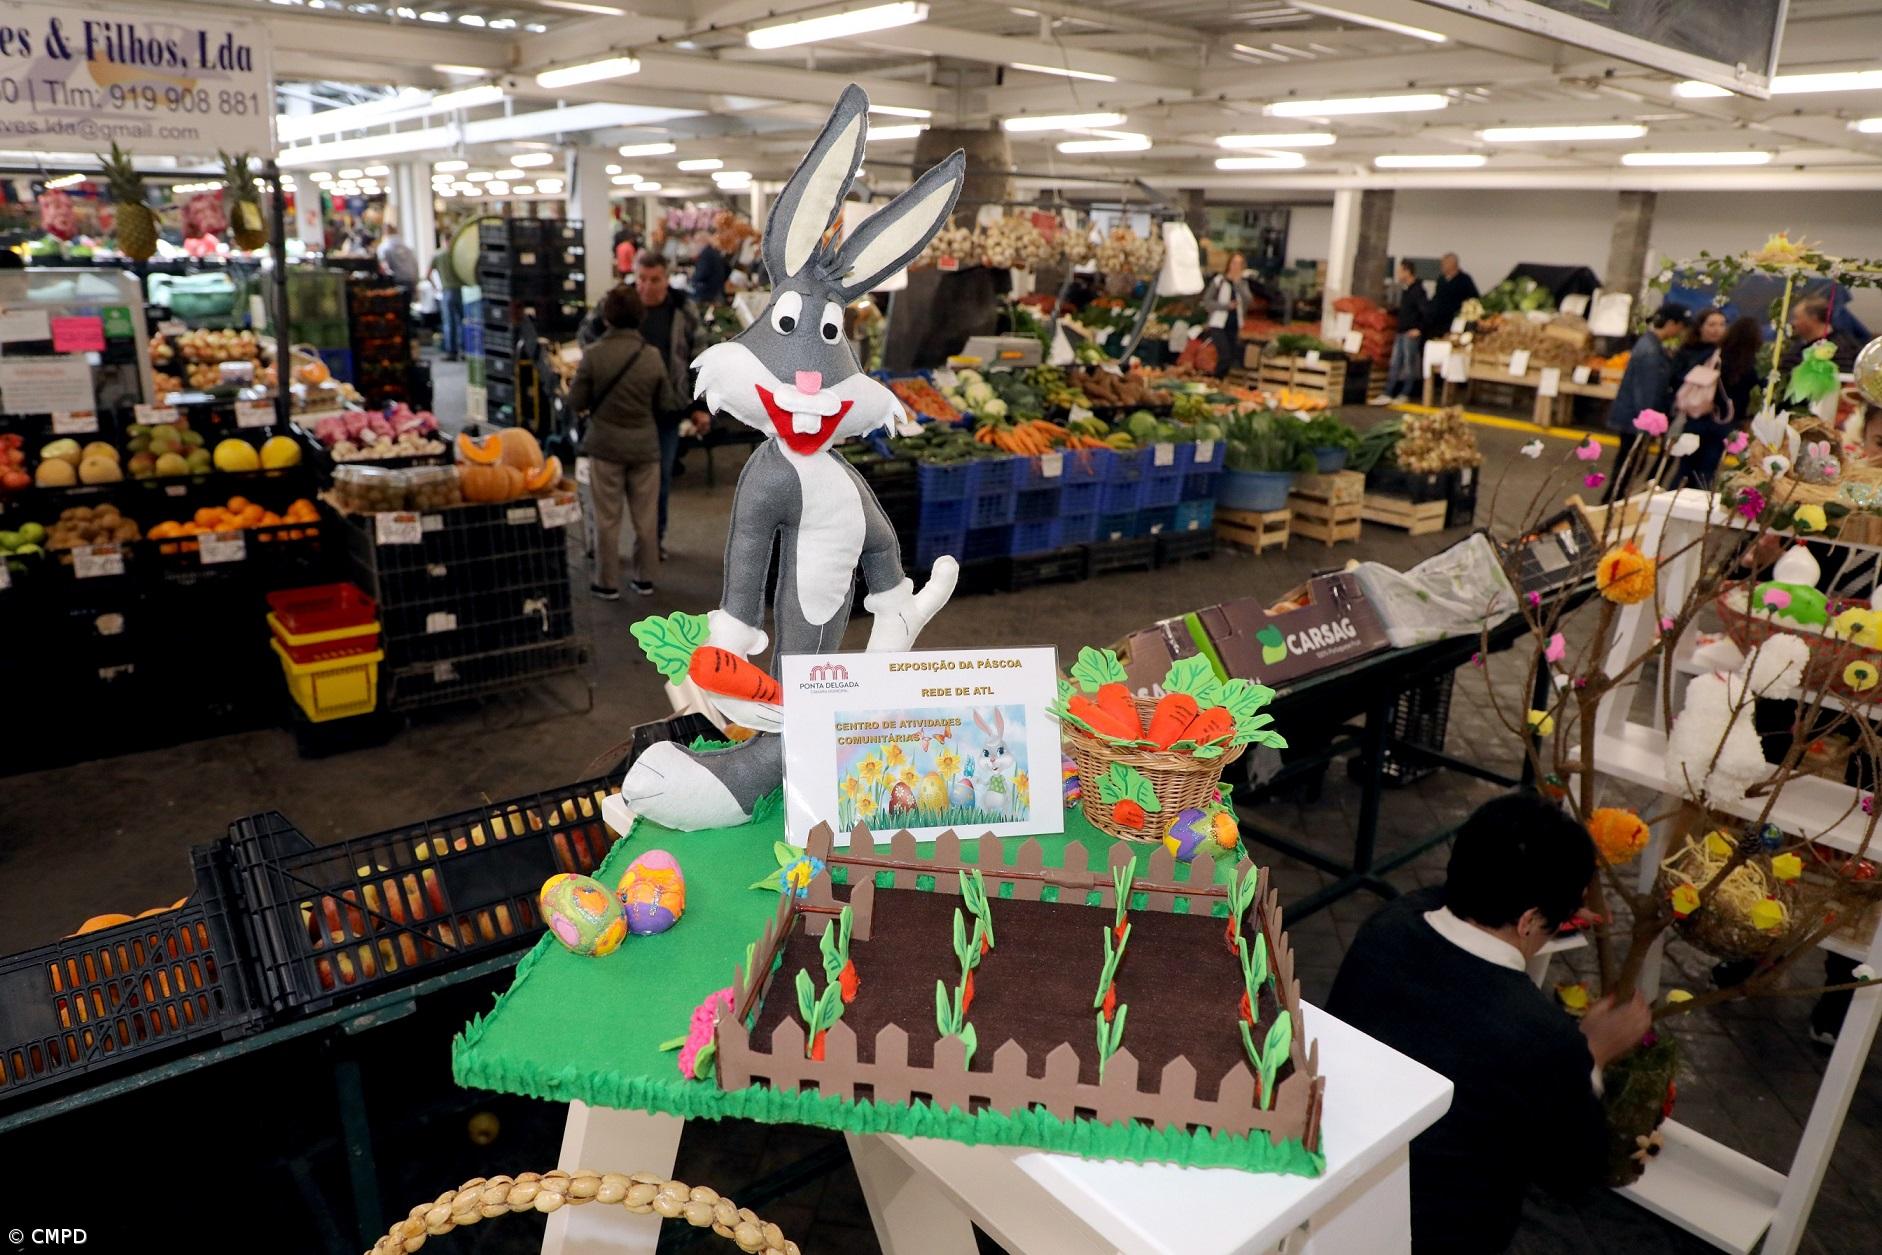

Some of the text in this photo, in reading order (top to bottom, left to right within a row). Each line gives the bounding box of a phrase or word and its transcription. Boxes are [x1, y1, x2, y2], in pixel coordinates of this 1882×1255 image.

[45, 17, 72, 60] &
[198, 30, 252, 71] Lda
[0, 77, 19, 104] 0
[42, 79, 103, 108] Tlm:
[110, 84, 157, 110] 919
[165, 87, 210, 114] 908
[219, 90, 259, 115] 881
[1286, 617, 1357, 655] CARSAG
[889, 659, 1022, 672] EXPOSIÇÃO DA PÁSCOA
[826, 681, 860, 689] DELGADA
[921, 686, 994, 697] REDE DE ATL
[835, 718, 962, 731] CENTRO DE ATIVIDADES
[838, 733, 921, 745] COMUNITÁRIAS
